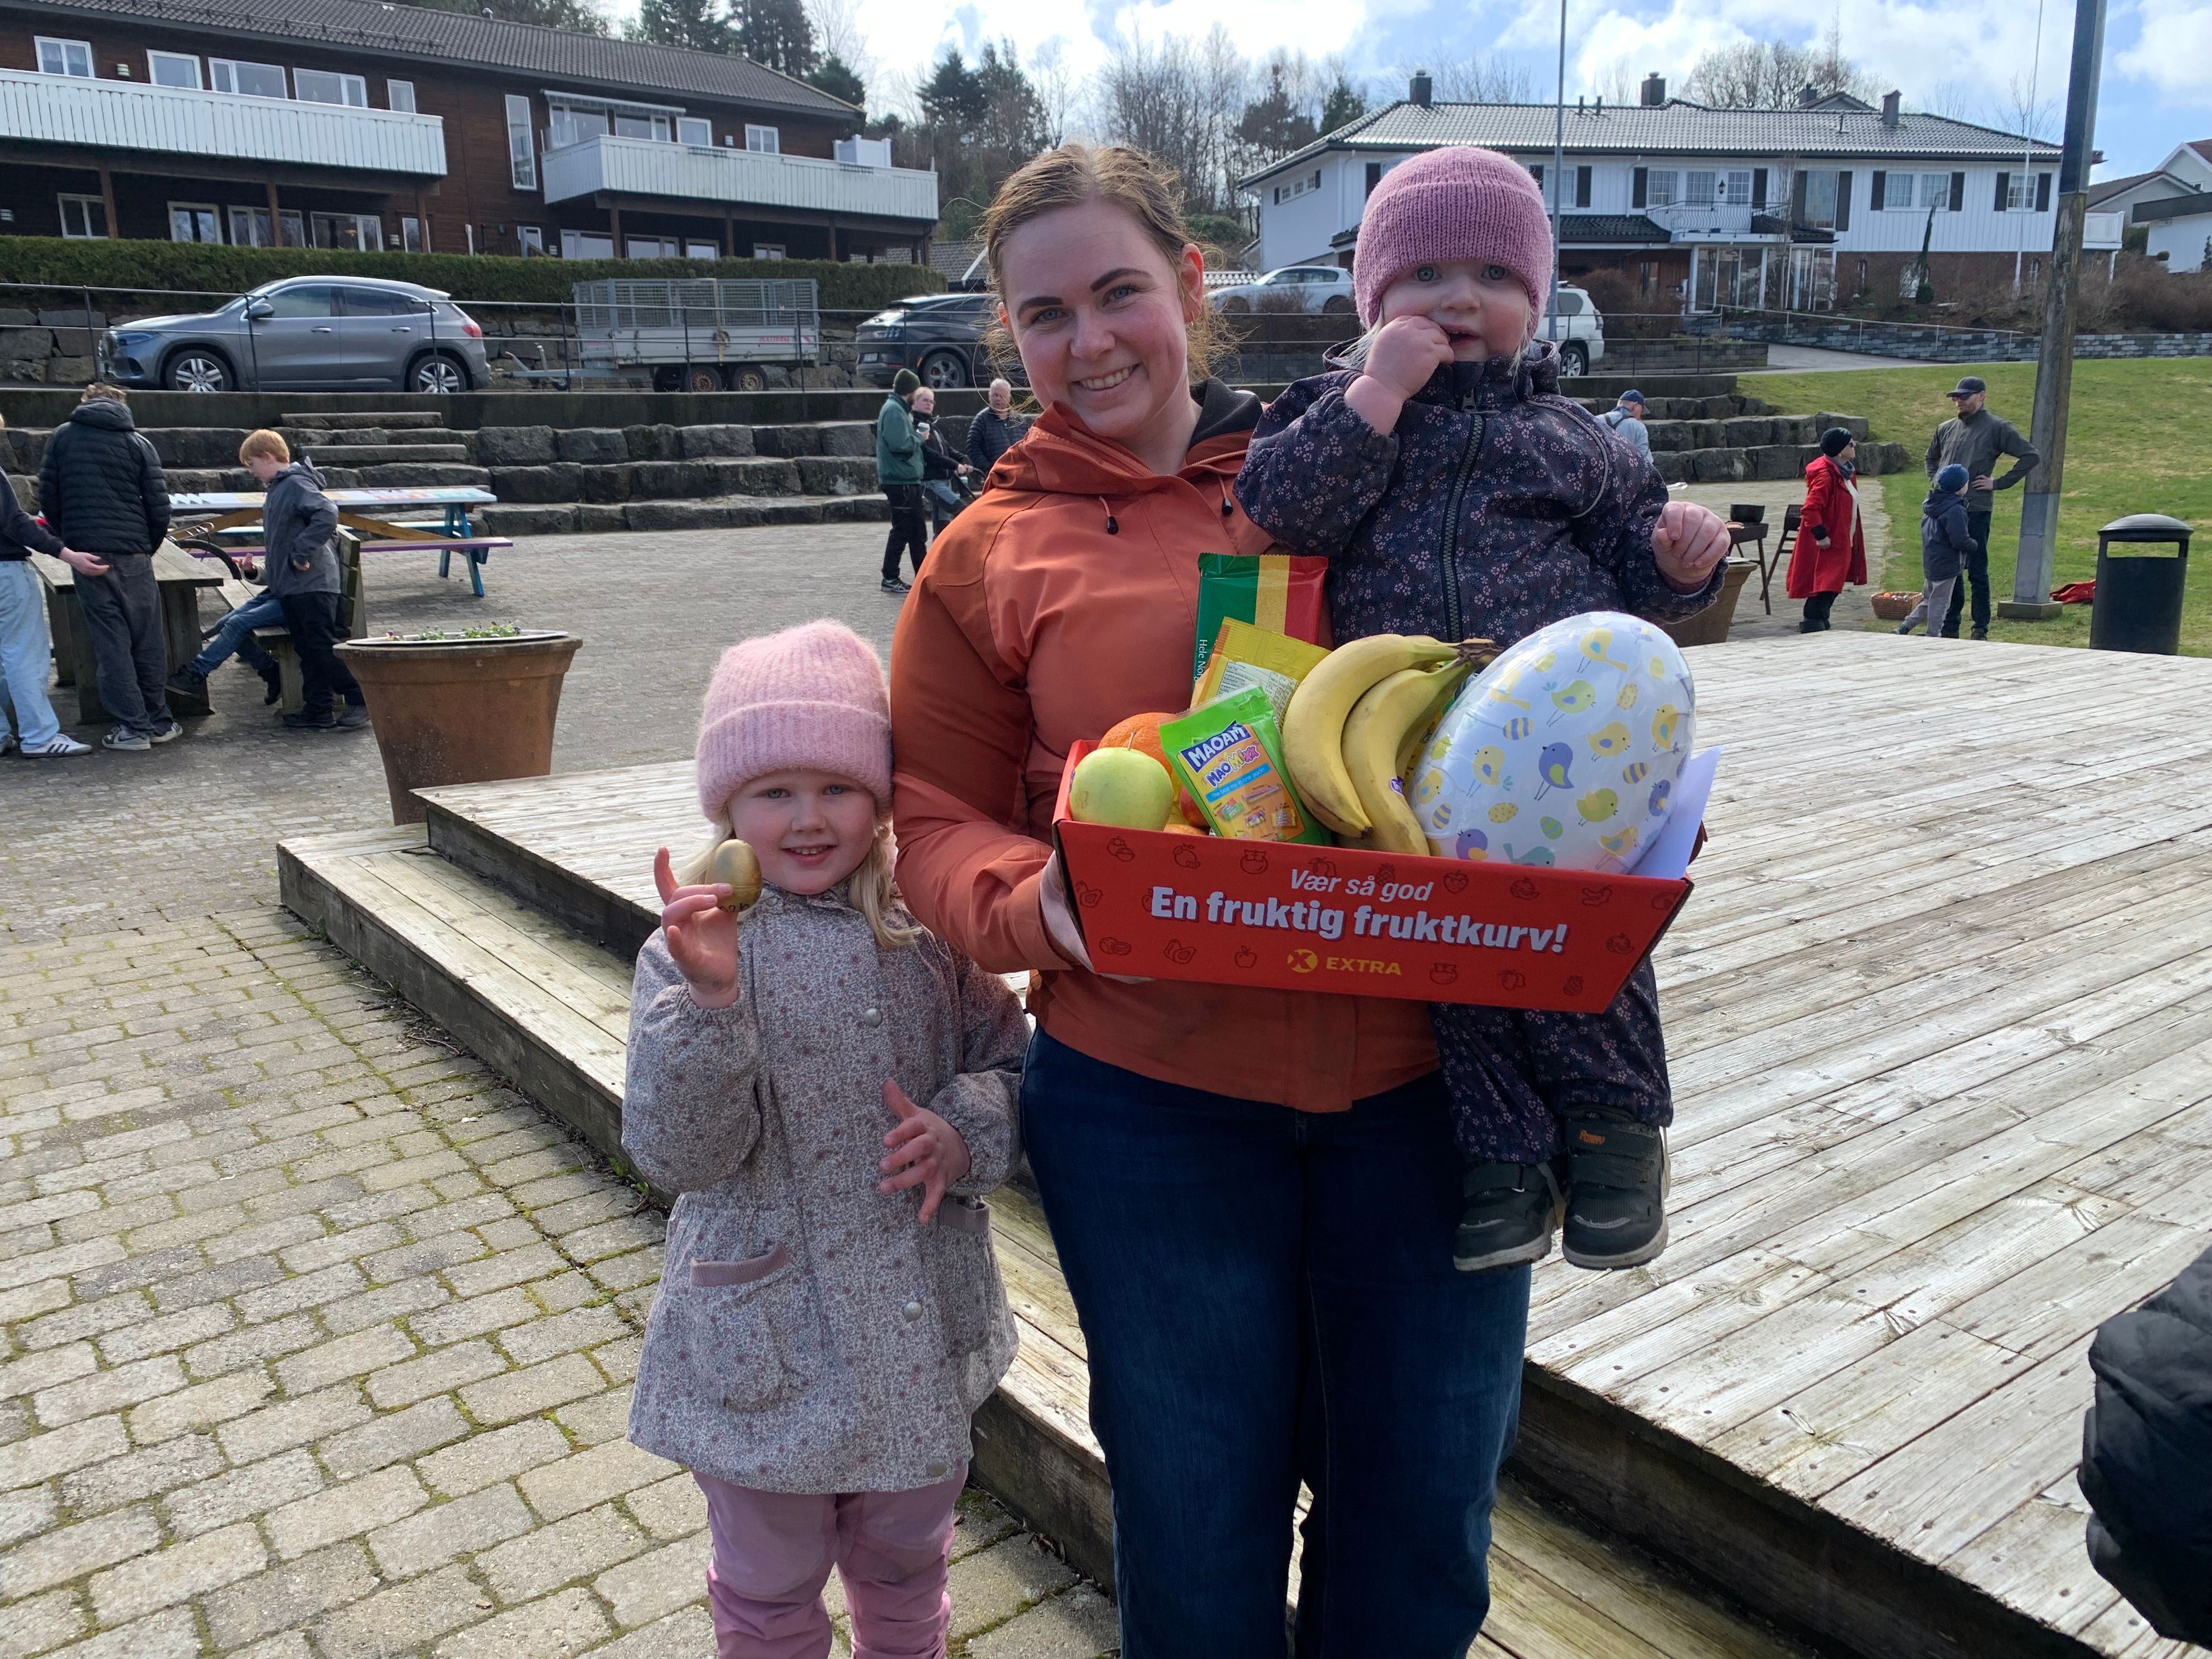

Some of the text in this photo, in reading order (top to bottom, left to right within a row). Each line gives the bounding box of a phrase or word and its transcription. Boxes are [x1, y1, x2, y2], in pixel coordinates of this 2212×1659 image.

[1198, 639, 1208, 659] Hele
[1187, 723, 1246, 768] MAOAM
[1291, 868, 1434, 902] Vær så god
[1150, 885, 1570, 955] En fruktig fruktkurv!
[1325, 956, 1402, 975] EXTRA
